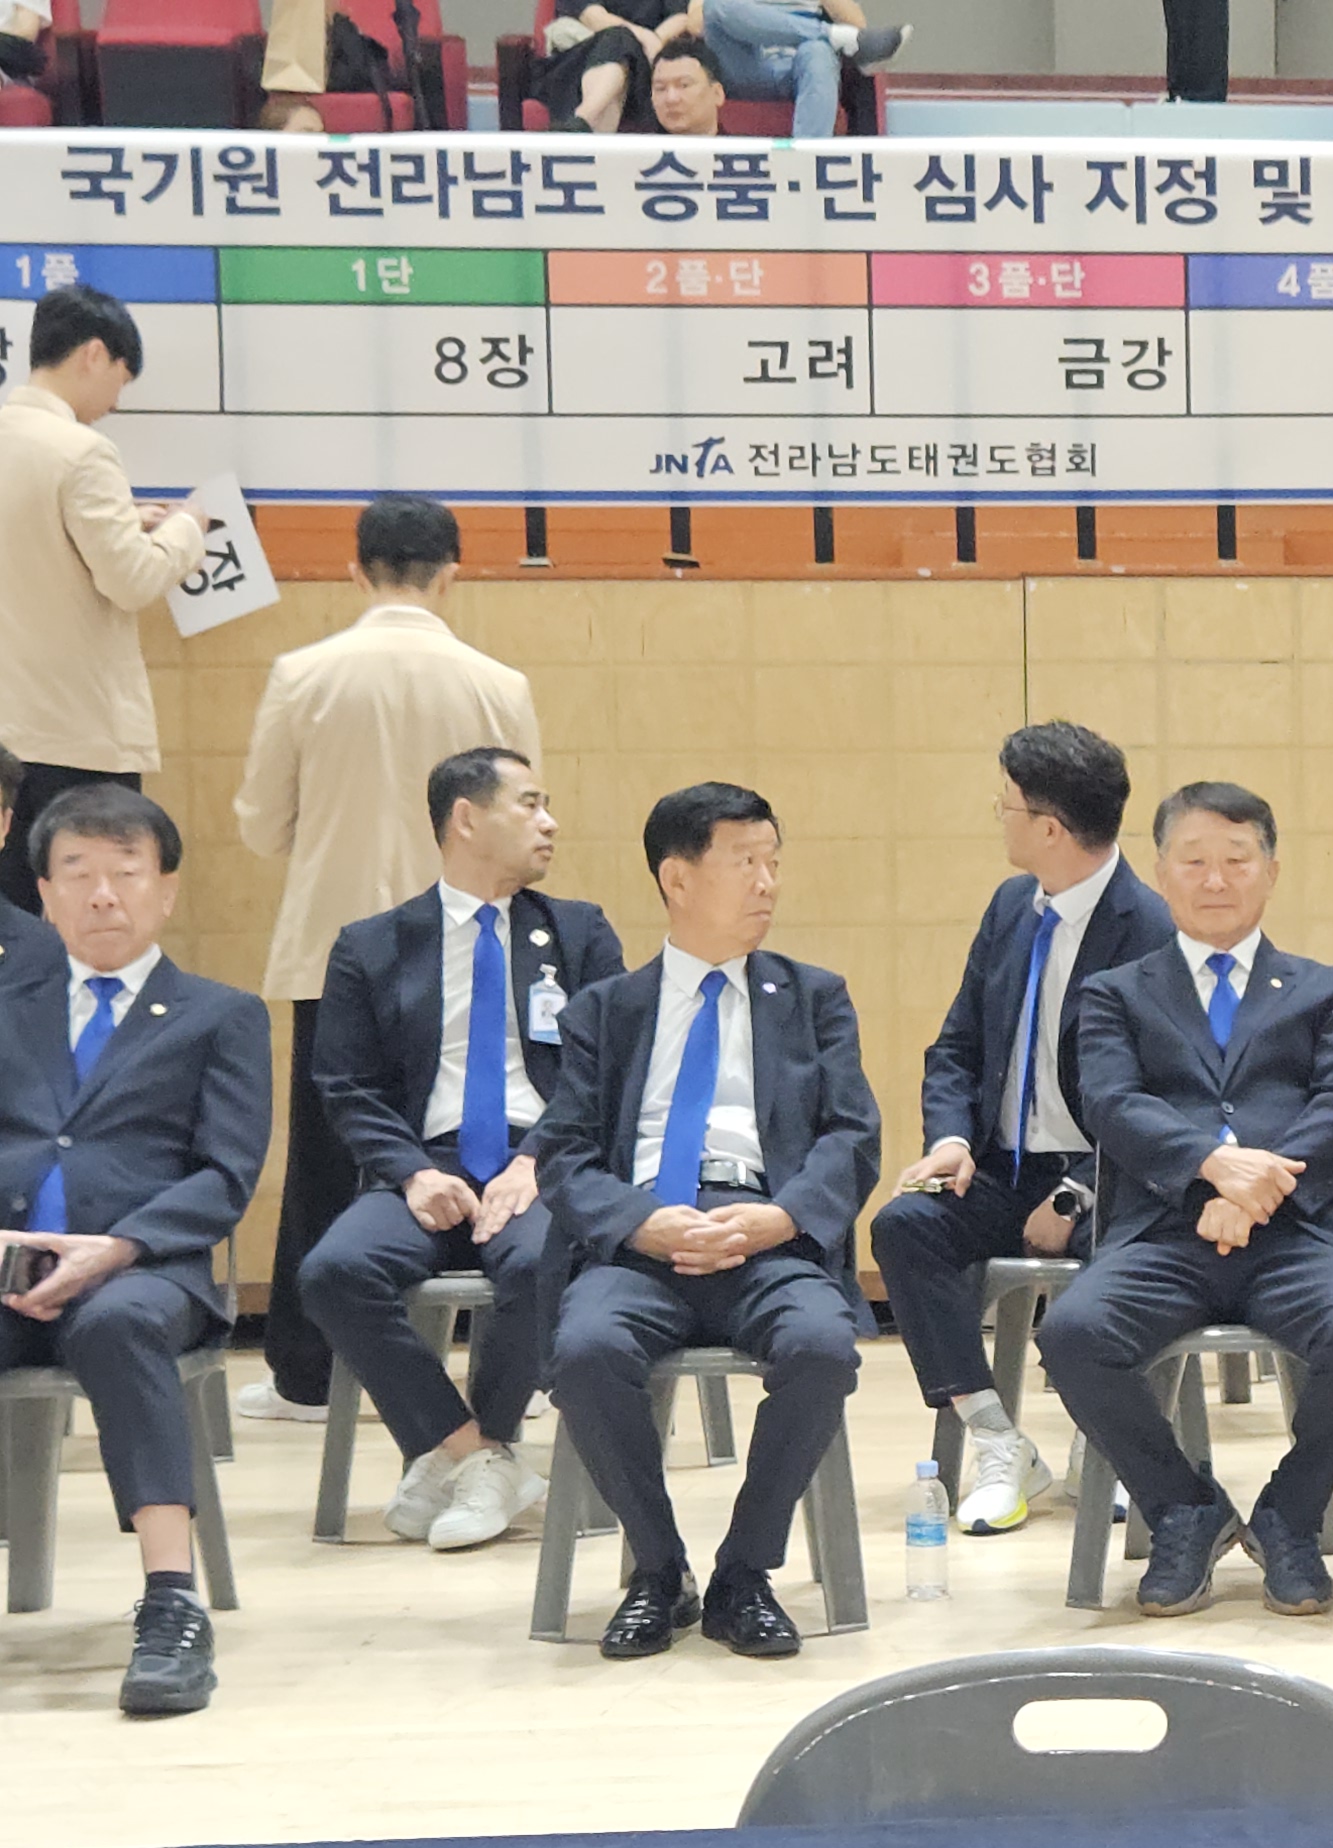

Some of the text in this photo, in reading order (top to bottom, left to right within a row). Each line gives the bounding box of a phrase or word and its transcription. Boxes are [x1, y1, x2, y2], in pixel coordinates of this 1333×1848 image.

[61, 145, 281, 218] 국기원
[315, 147, 605, 220] 전라남도
[634, 151, 883, 223] 승품·단
[913, 154, 1054, 224] 심사
[1085, 156, 1218, 226] 지정
[1253, 157, 1313, 225] 및
[352, 257, 413, 294] 1단
[646, 259, 763, 295] 2품·단
[968, 261, 1085, 298] 3품·단
[434, 334, 534, 388] 8장
[743, 336, 856, 390] 고려
[1058, 337, 1172, 390] 금강
[749, 441, 1098, 478] 전라남도태권도협회
[180, 517, 247, 597] 장
